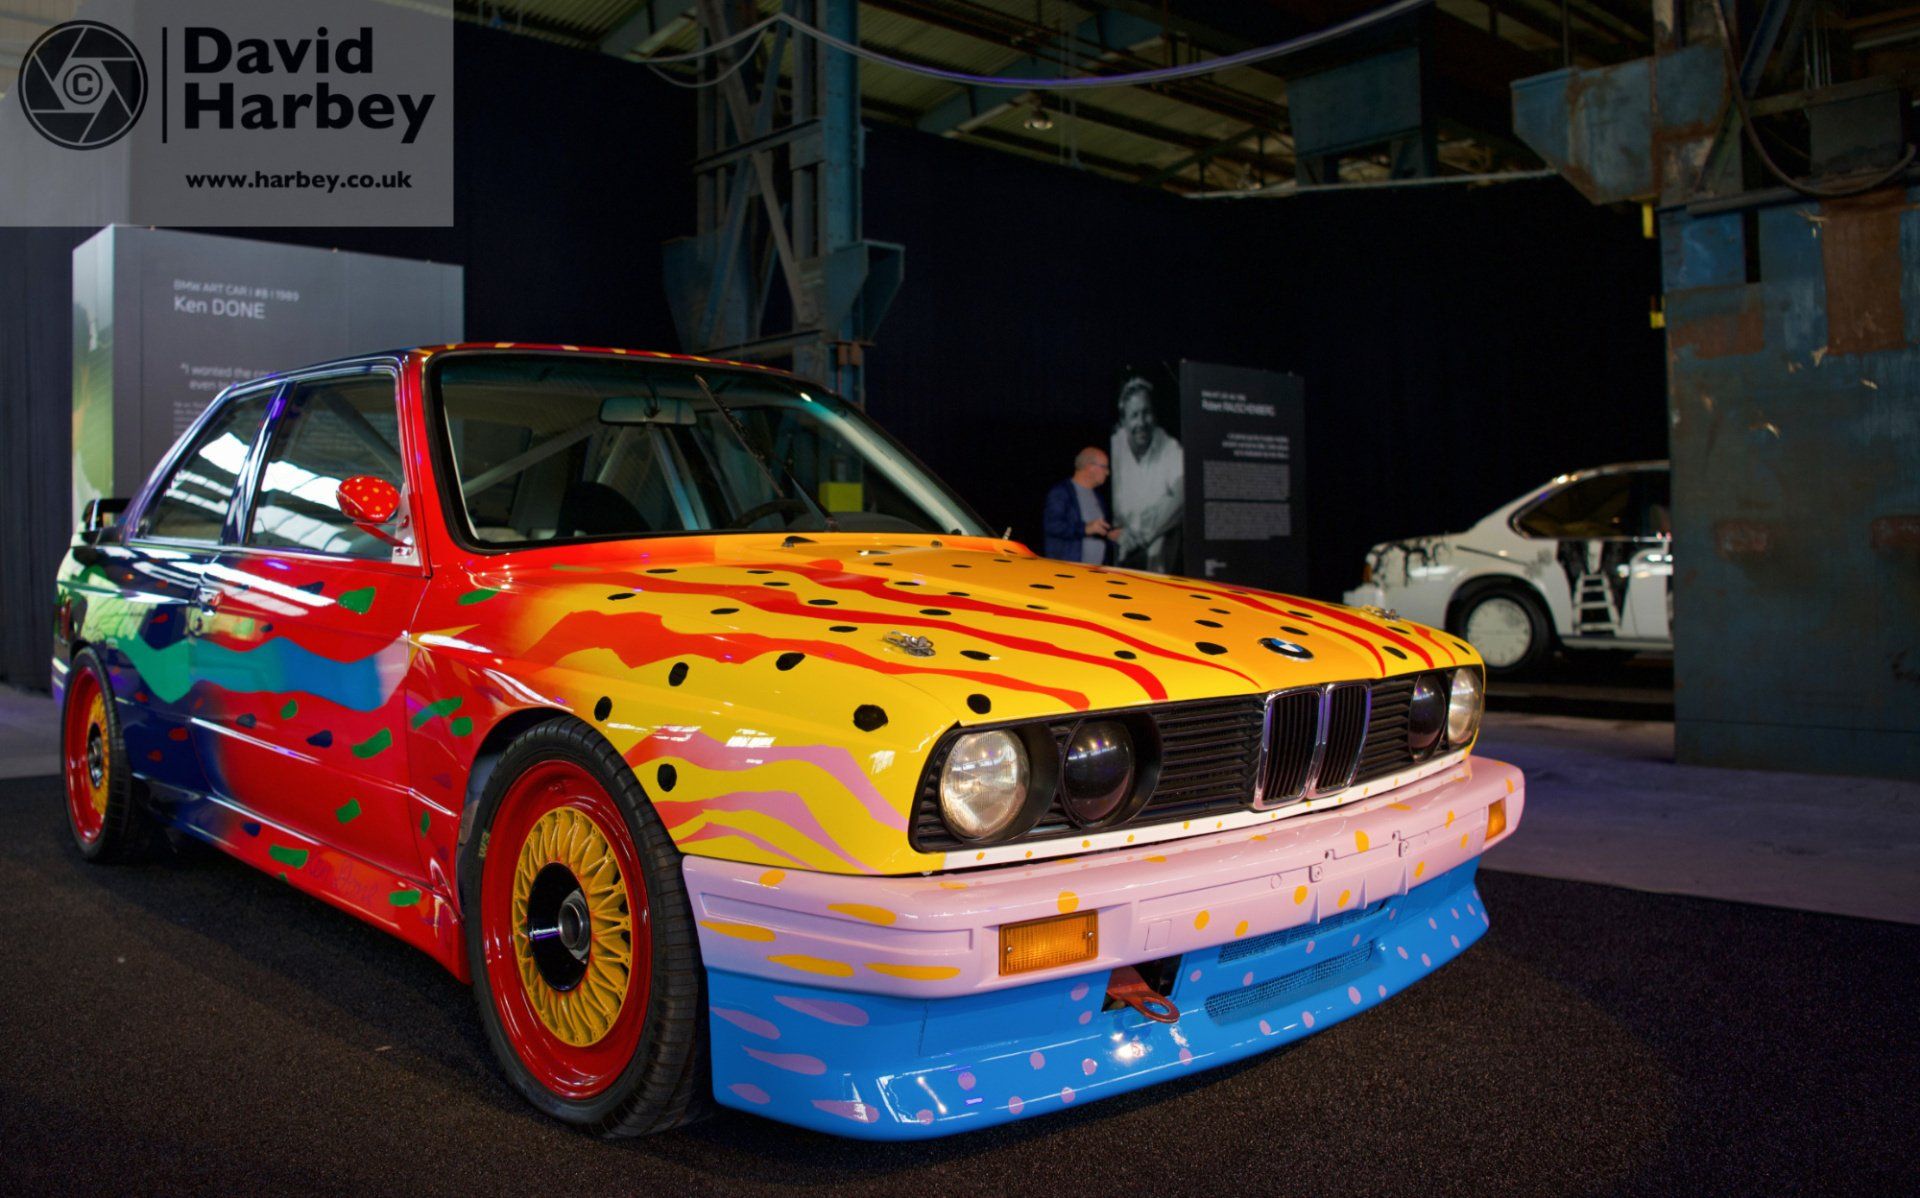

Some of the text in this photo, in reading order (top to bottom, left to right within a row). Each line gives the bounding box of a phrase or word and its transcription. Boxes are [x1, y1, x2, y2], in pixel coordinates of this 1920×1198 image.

[225, 283, 248, 296] CAR
[173, 295, 266, 319] Ken DONE
